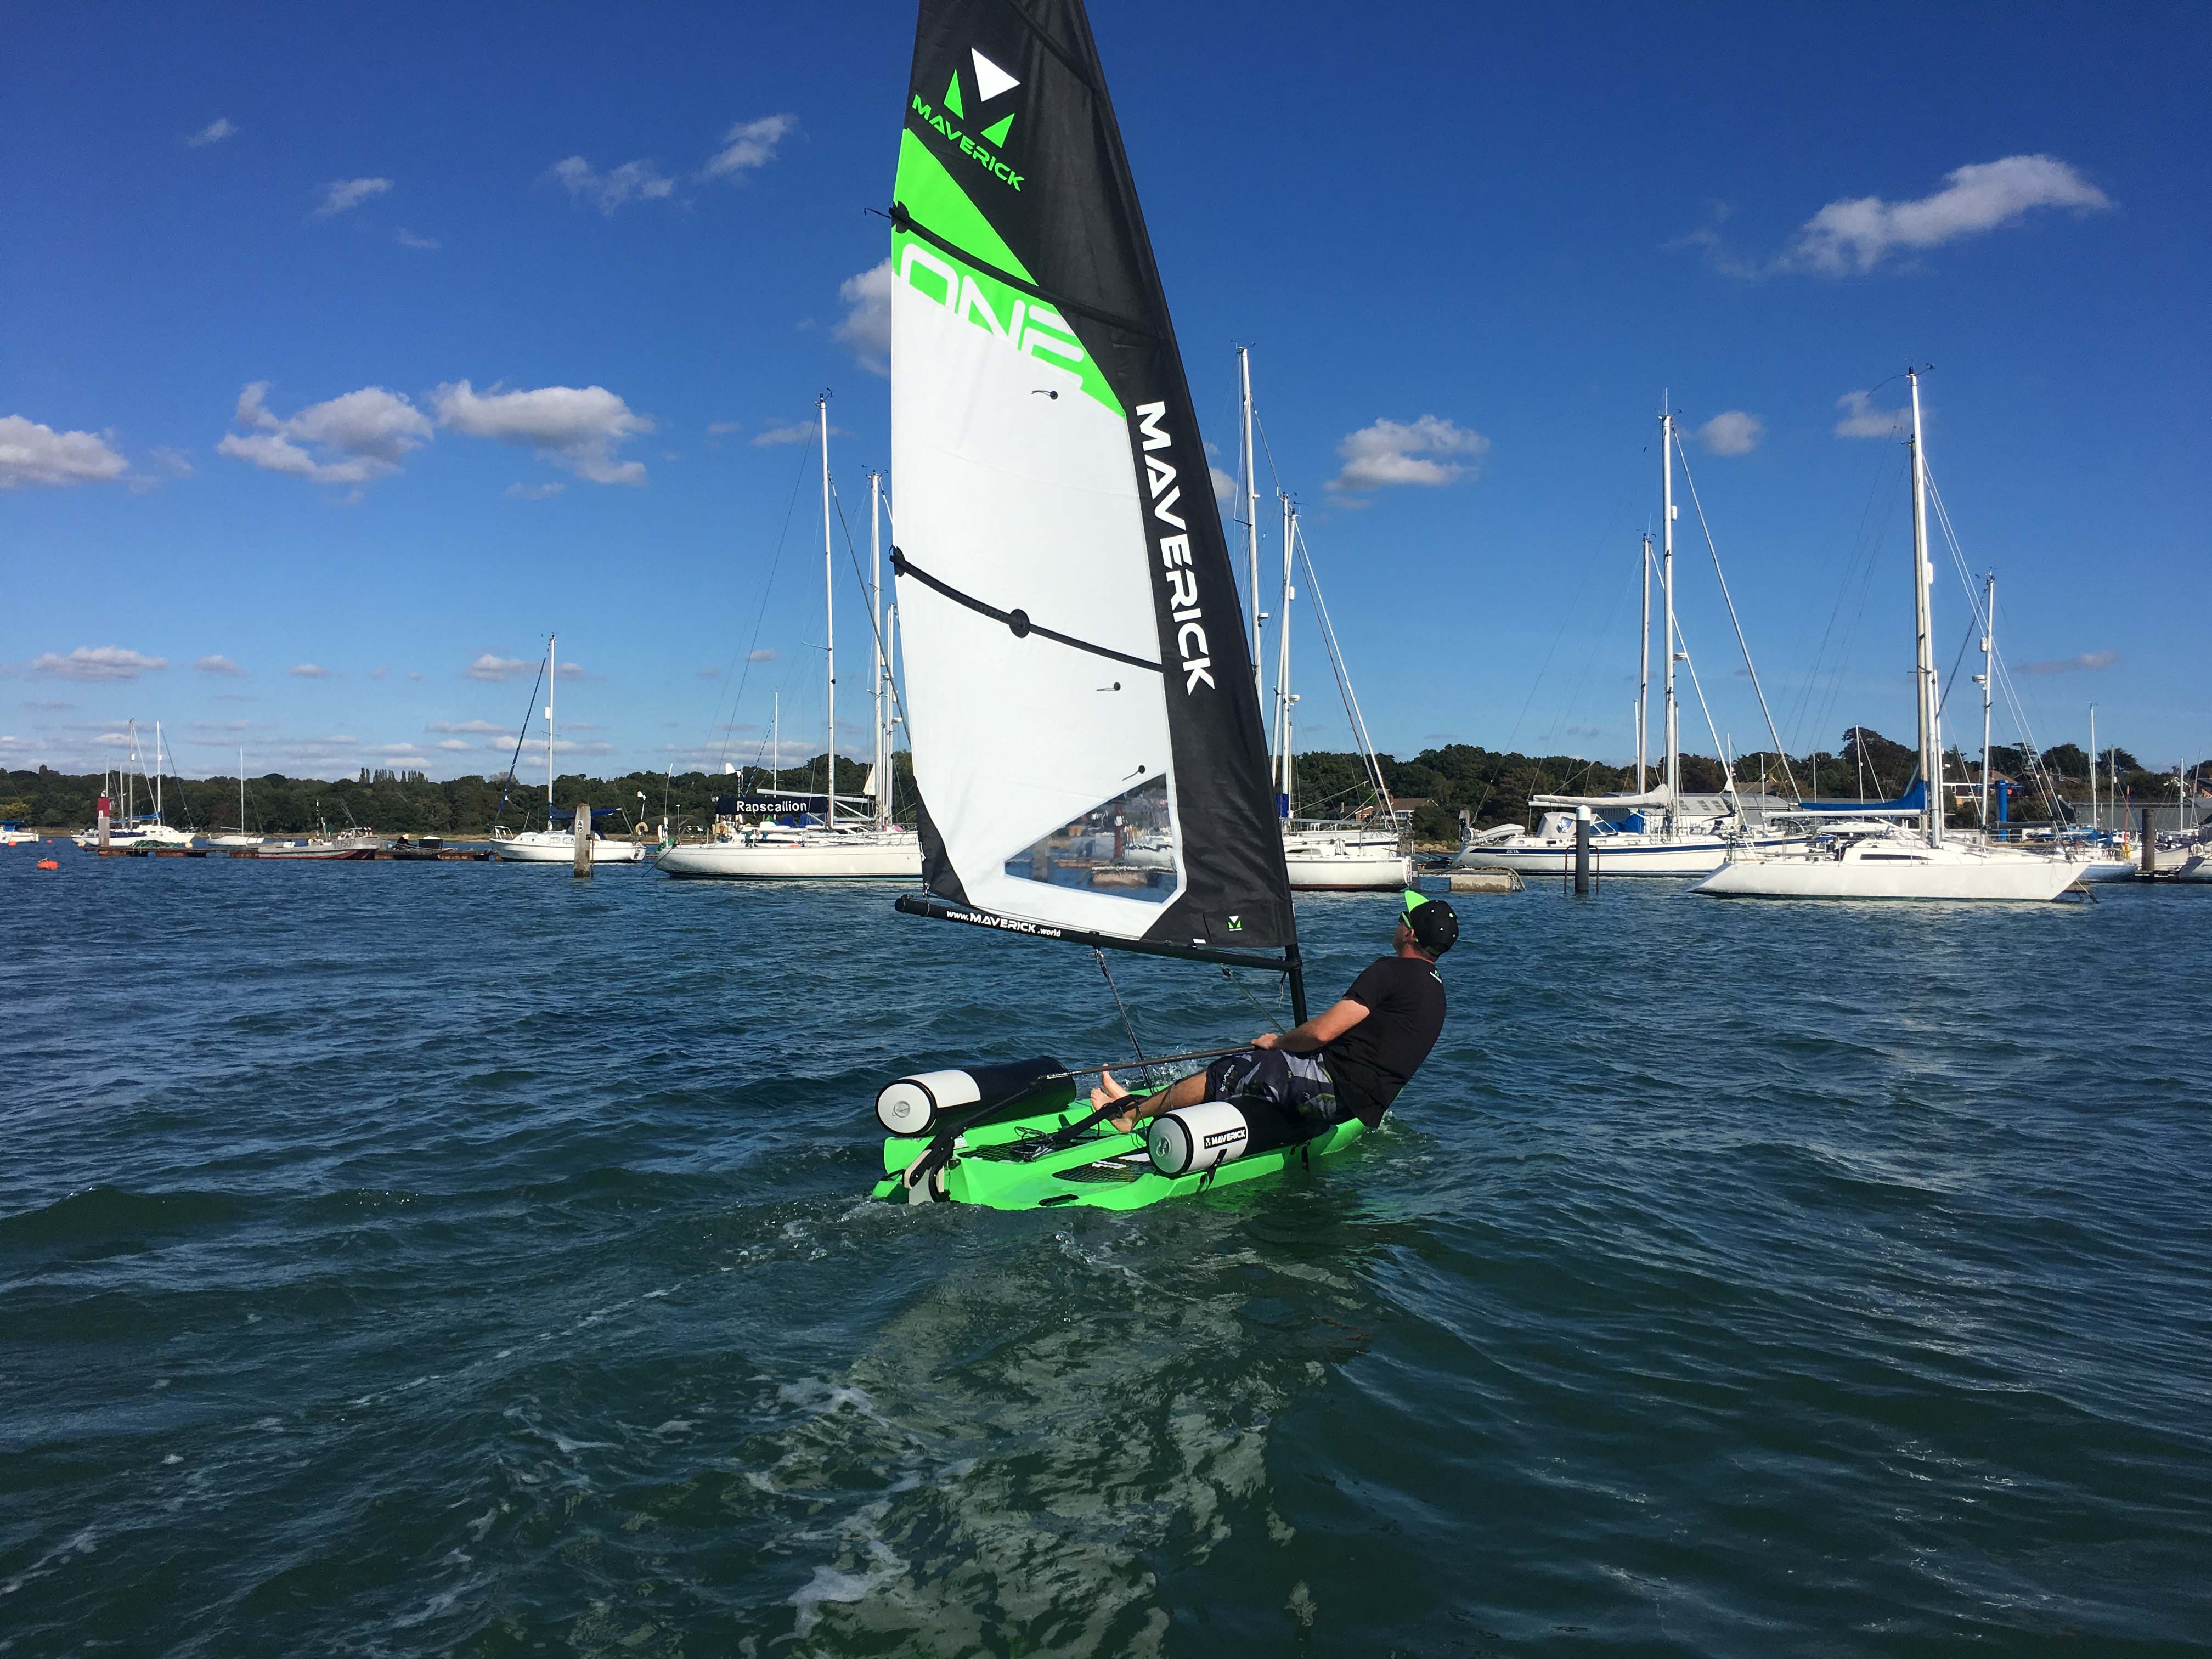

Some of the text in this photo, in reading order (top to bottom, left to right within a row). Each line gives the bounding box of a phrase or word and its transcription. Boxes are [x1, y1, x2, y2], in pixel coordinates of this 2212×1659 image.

[912, 94, 1025, 191] MAVERICK
[900, 242, 1084, 388] ONE
[1136, 401, 1215, 696] MAVERICK
[737, 800, 807, 814] Rapscallion
[1211, 1129, 1246, 1146] MAVERICK
